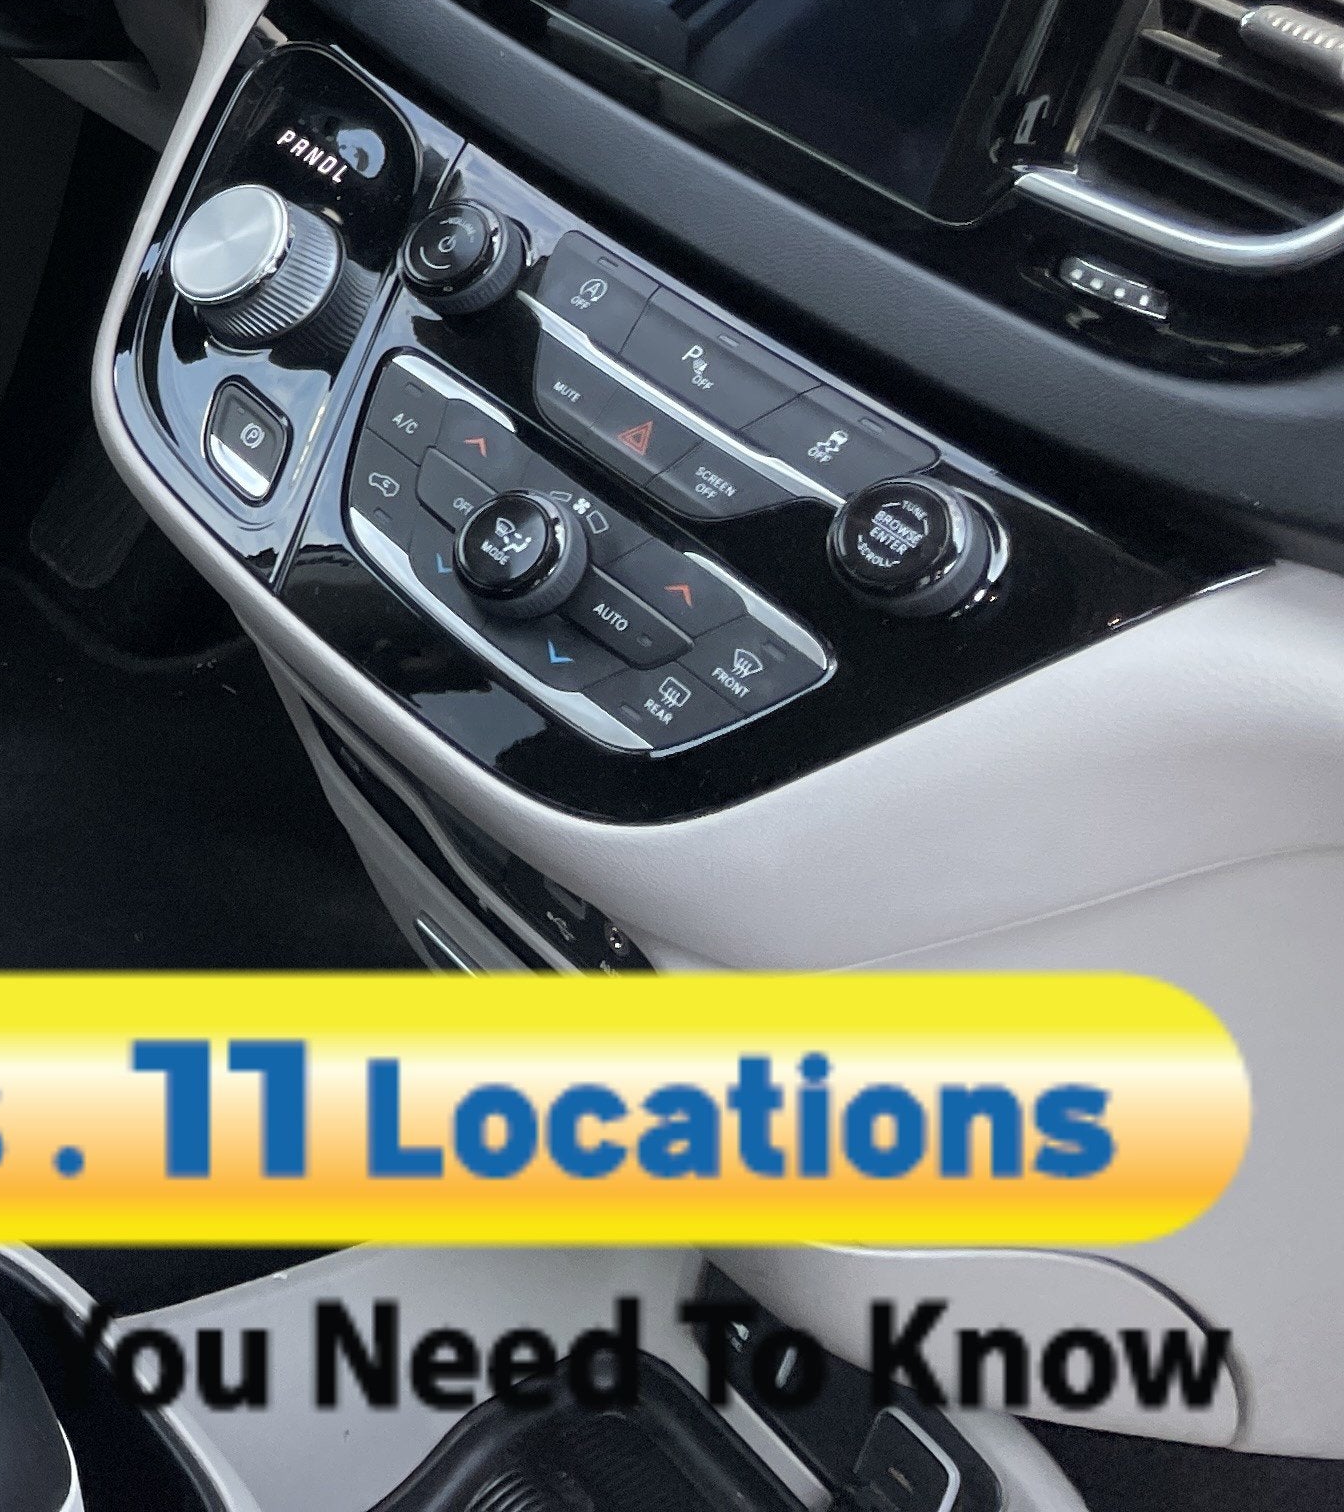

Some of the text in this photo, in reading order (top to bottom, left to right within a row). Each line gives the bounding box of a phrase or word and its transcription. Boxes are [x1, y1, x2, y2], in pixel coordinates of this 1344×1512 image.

[552, 381, 581, 403] MUTE
[691, 374, 714, 389] OFF
[392, 412, 419, 435] A/C
[695, 467, 736, 497] SCREEN
[695, 483, 718, 499] OFF
[869, 526, 908, 556] ENTER
[874, 510, 924, 545] BROWSE
[481, 539, 510, 566] MODE
[593, 603, 629, 632] AUTO
[711, 667, 751, 698] FRONT
[643, 698, 674, 726] REAR
